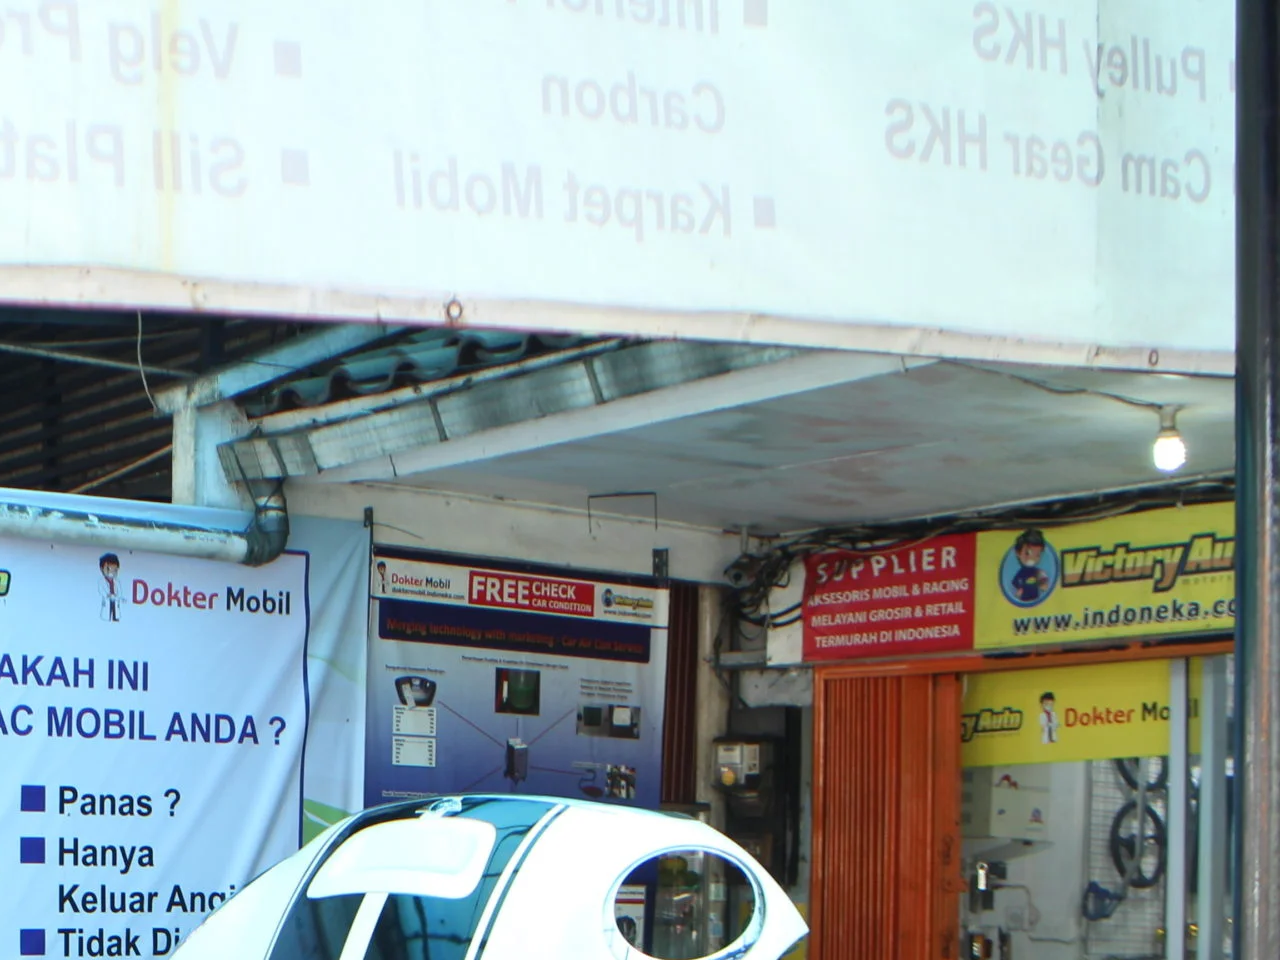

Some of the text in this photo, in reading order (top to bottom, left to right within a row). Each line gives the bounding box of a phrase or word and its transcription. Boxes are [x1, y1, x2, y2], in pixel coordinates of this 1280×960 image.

[816, 546, 957, 584] SUPPLIER
[1061, 532, 1235, 593] Victory Au
[391, 573, 450, 590] Dokter Mobil
[472, 575, 576, 606] FREE CHECK
[808, 578, 969, 606] AKSESORIS MOBIL & RACING
[131, 579, 291, 615] Dokter Mobil
[532, 598, 592, 612] CAR CONDITION
[811, 602, 965, 627] MELAYANI GROSIR & RETAIL
[1013, 598, 1237, 635] www.indoneka.co
[815, 624, 960, 648] TERMURAH DI INDONESIA
[107, 659, 149, 691] INI
[47, 706, 157, 741] MOBIL
[165, 711, 259, 744] ANDA
[268, 716, 287, 745] ?
[1064, 706, 1135, 728] Dokter
[58, 786, 181, 816] Panas ?
[58, 837, 154, 874] Hanya
[58, 884, 158, 913] Keluar
[57, 928, 180, 957] Tidak Di
